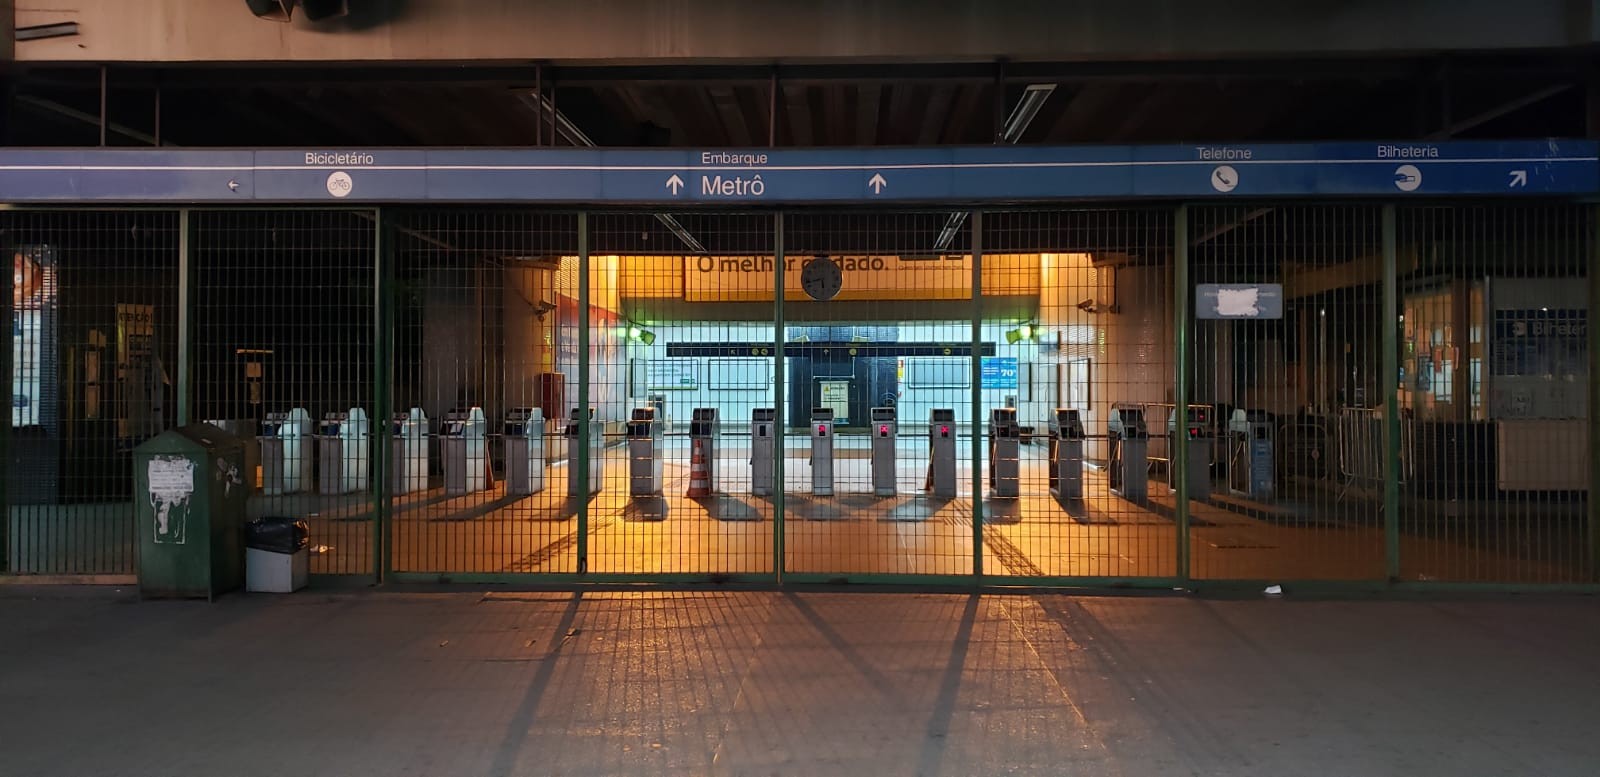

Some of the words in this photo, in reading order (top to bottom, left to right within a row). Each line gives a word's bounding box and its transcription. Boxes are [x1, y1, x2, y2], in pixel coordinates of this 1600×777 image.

[305, 151, 374, 165] Bicicletário
[702, 151, 768, 167] Embarque
[1195, 147, 1252, 160] Telefone
[1377, 145, 1439, 158] Bilheteria
[702, 174, 765, 196] Metrô
[697, 256, 714, 273] O
[720, 256, 795, 273] melhr
[802, 256, 888, 271] cdado.
